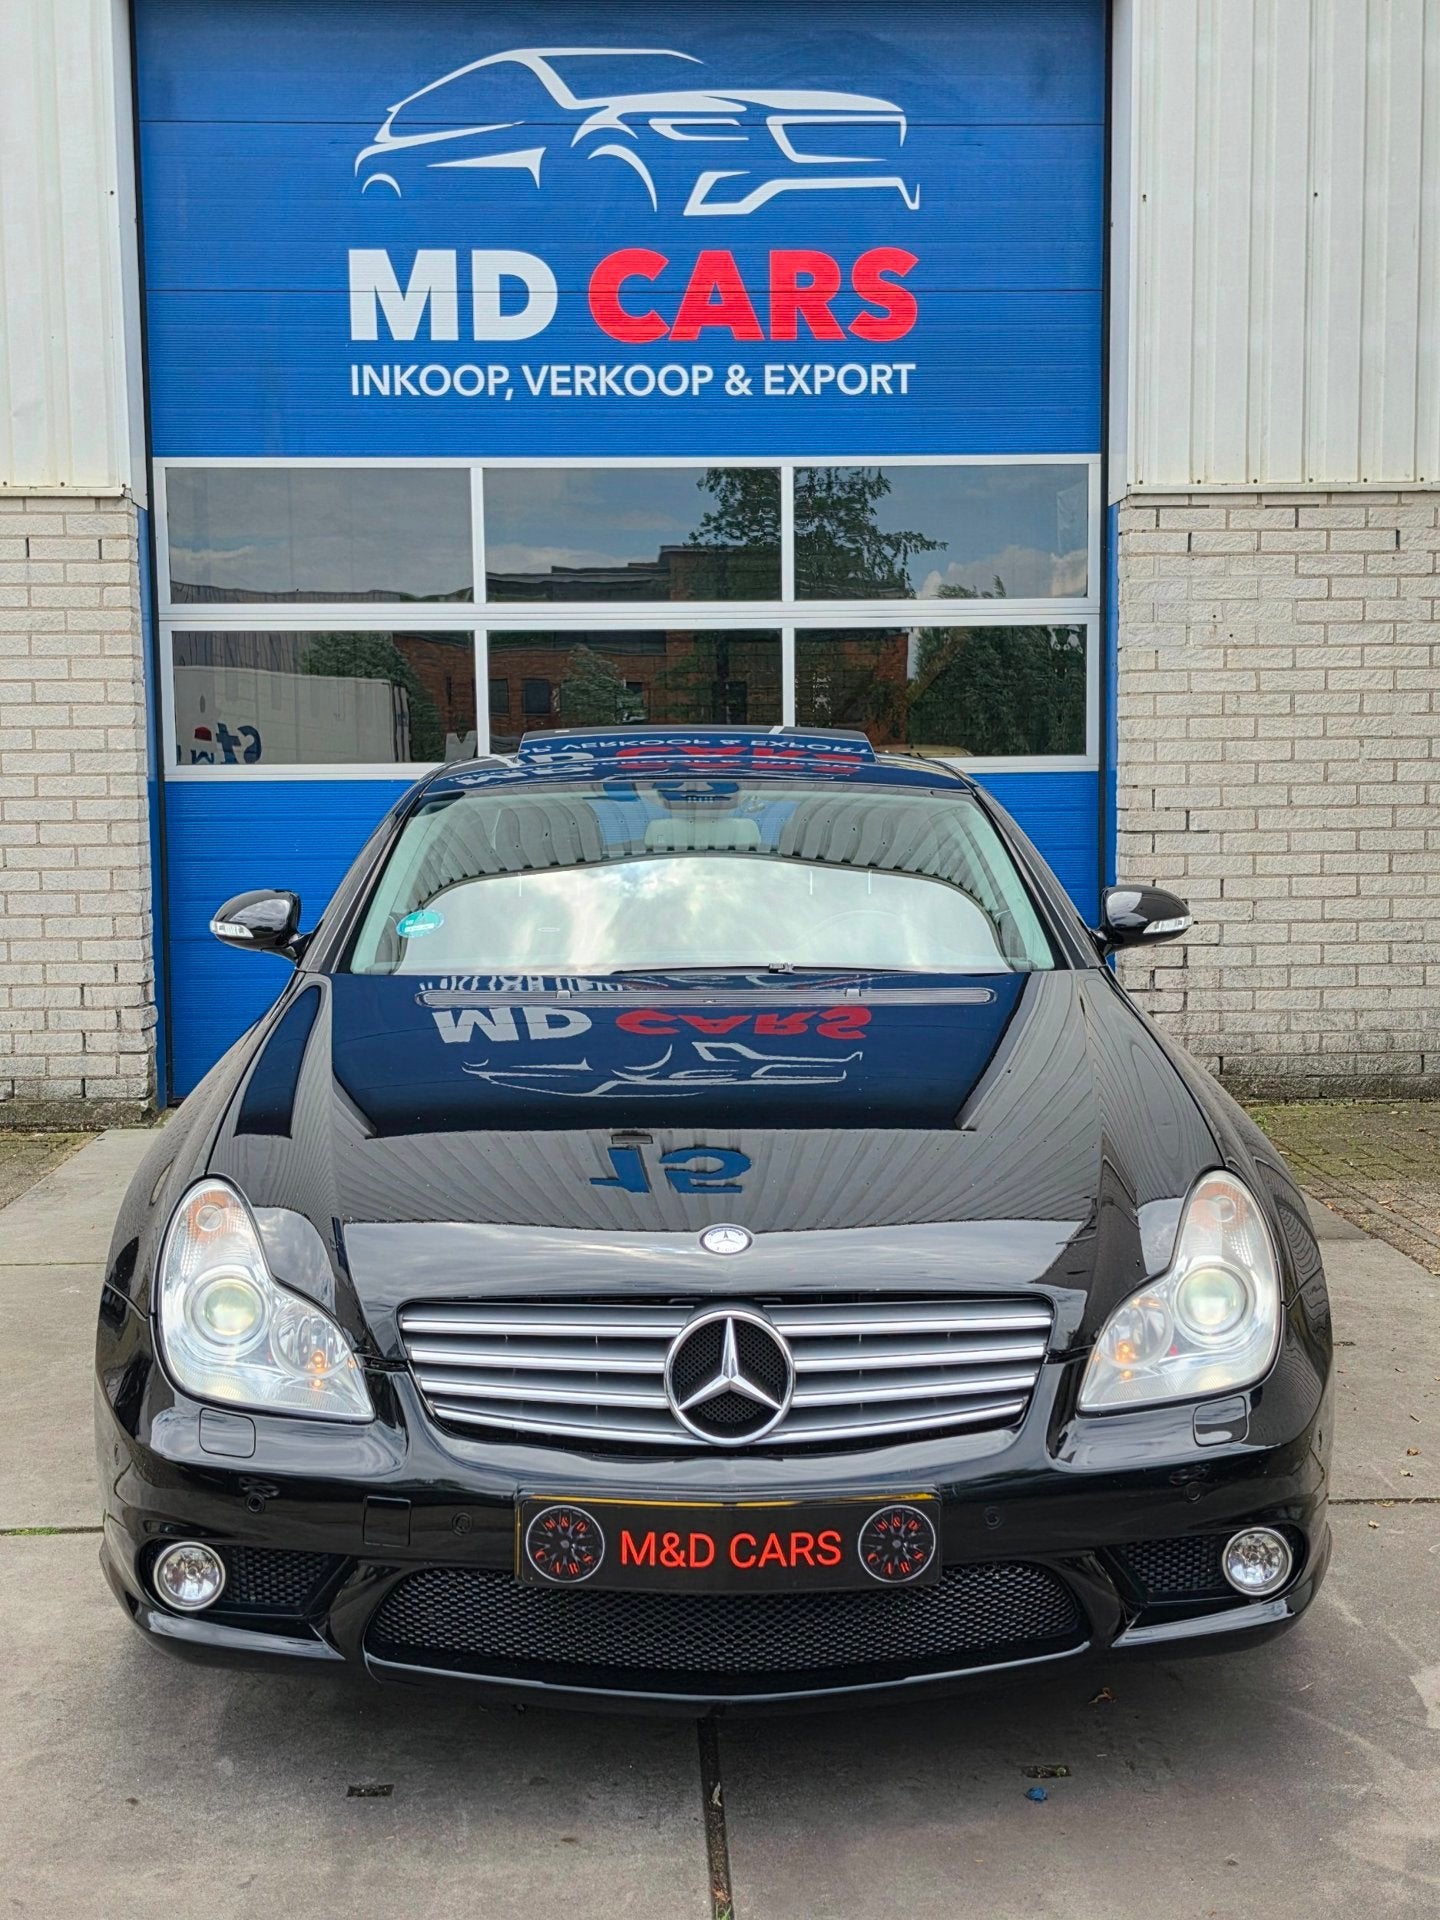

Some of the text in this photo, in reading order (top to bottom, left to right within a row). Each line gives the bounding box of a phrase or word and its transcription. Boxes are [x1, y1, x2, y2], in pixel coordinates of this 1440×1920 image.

[348, 247, 919, 343] MD CARS
[350, 364, 916, 401] INKOOP, VERKOOP & EXPORT
[621, 1530, 842, 1569] M&D CARS
